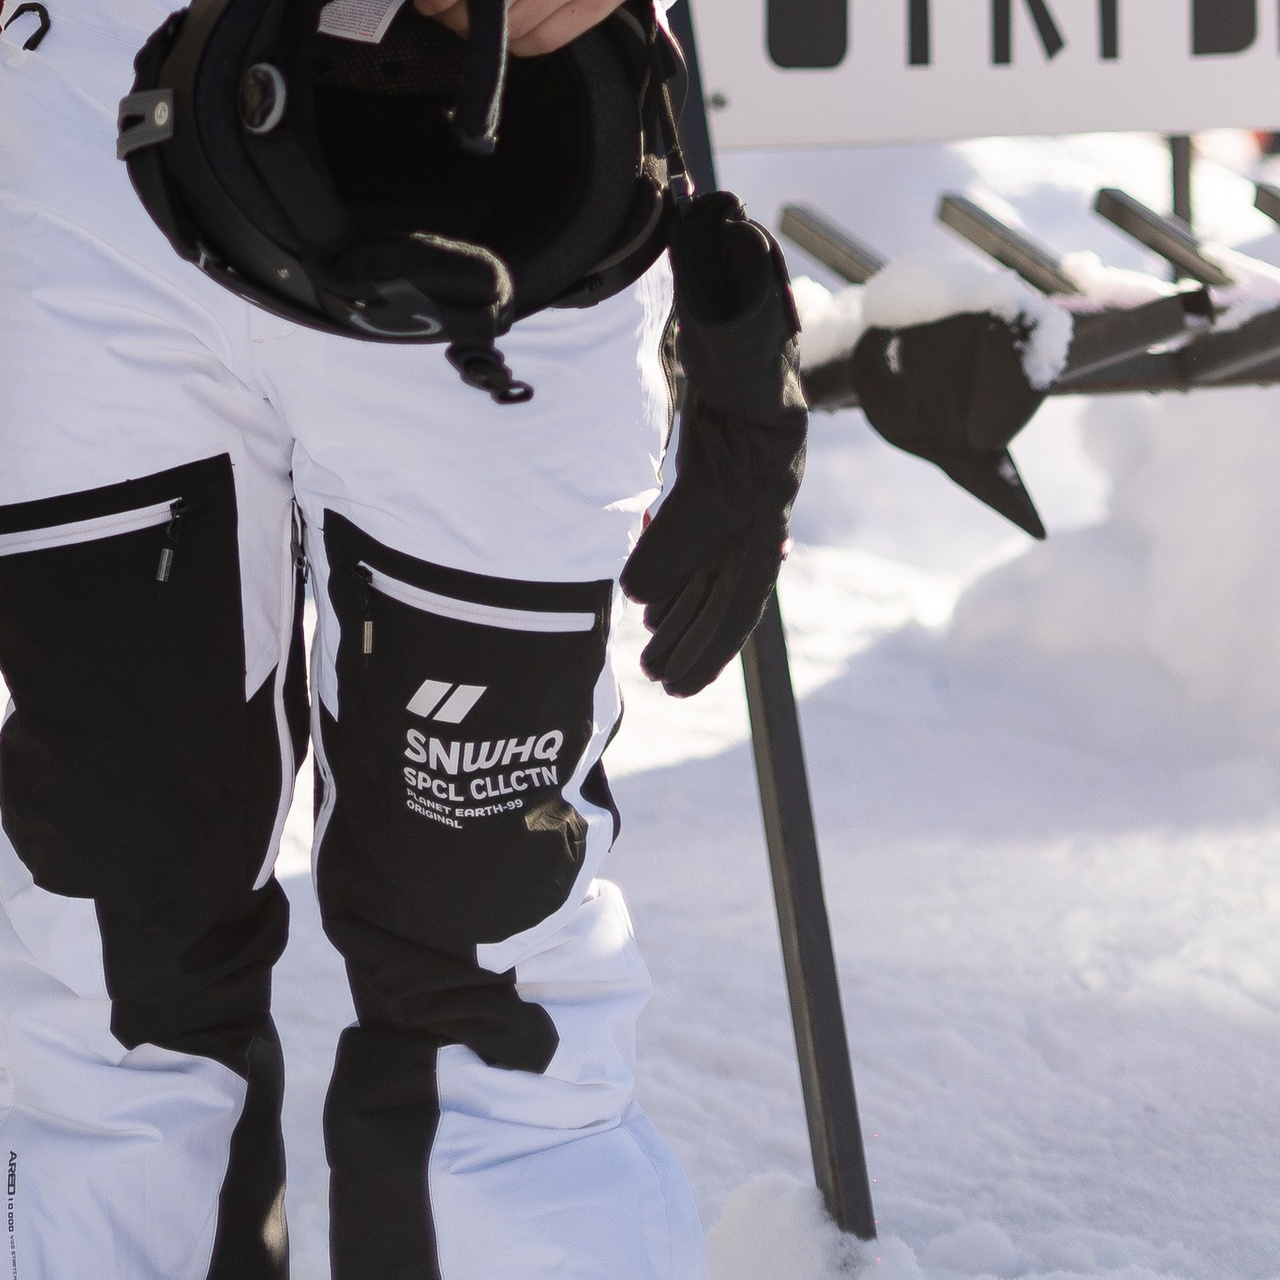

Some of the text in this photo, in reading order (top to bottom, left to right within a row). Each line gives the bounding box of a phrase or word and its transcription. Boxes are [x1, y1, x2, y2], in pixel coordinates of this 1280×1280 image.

[403, 728, 564, 776] SNWHQ
[403, 765, 559, 802] SPCL CLLCTN
[406, 788, 524, 817] PLANET EARTH-99
[406, 799, 463, 829] ORIGINAL
